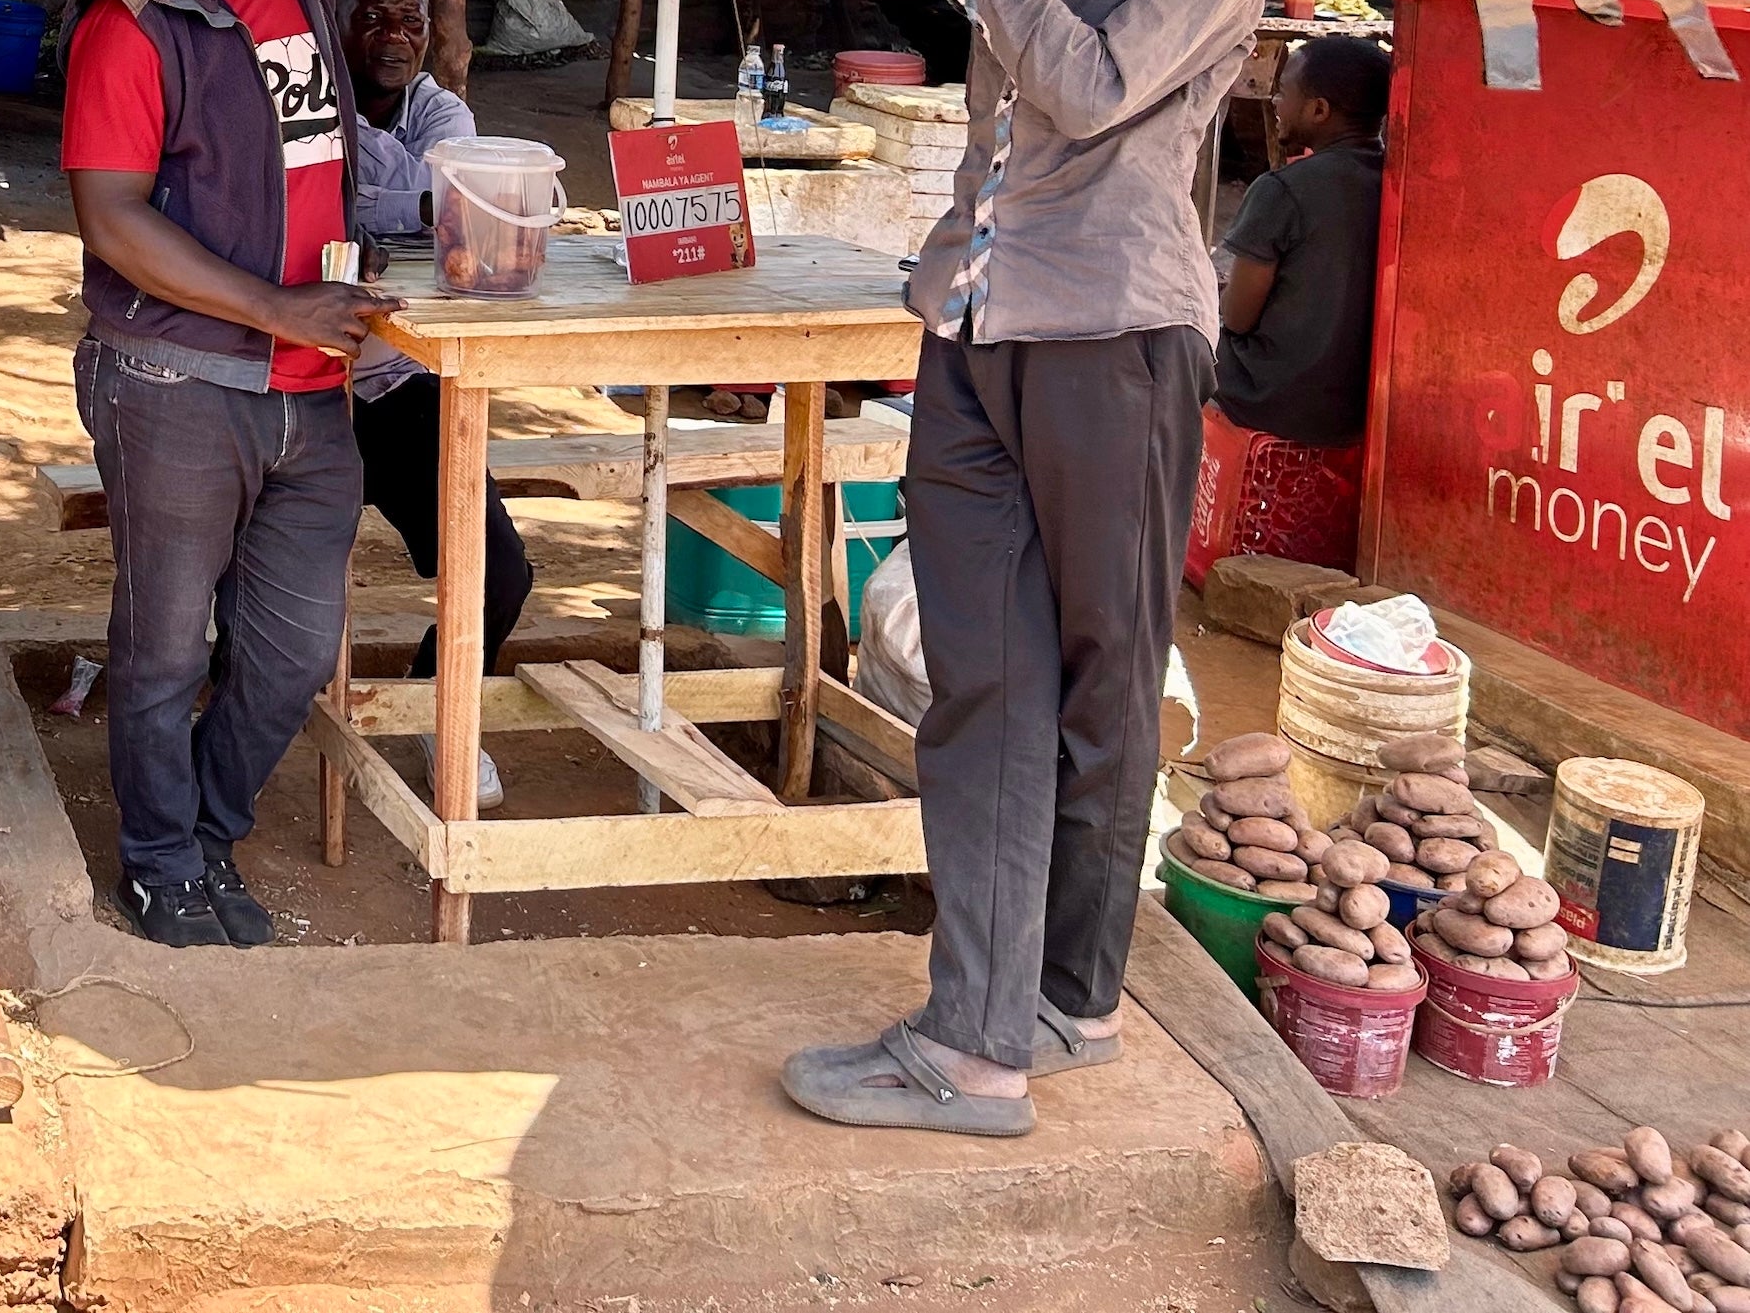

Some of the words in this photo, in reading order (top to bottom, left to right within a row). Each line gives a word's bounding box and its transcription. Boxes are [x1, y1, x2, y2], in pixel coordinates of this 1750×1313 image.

[665, 153, 686, 166] airtel
[641, 175, 679, 190] NAMBALA
[678, 176, 690, 186] YA
[689, 171, 715, 184] AGENT
[626, 189, 743, 237] 10007575
[1487, 465, 1717, 603] money
[1558, 906, 1587, 930] Plas
